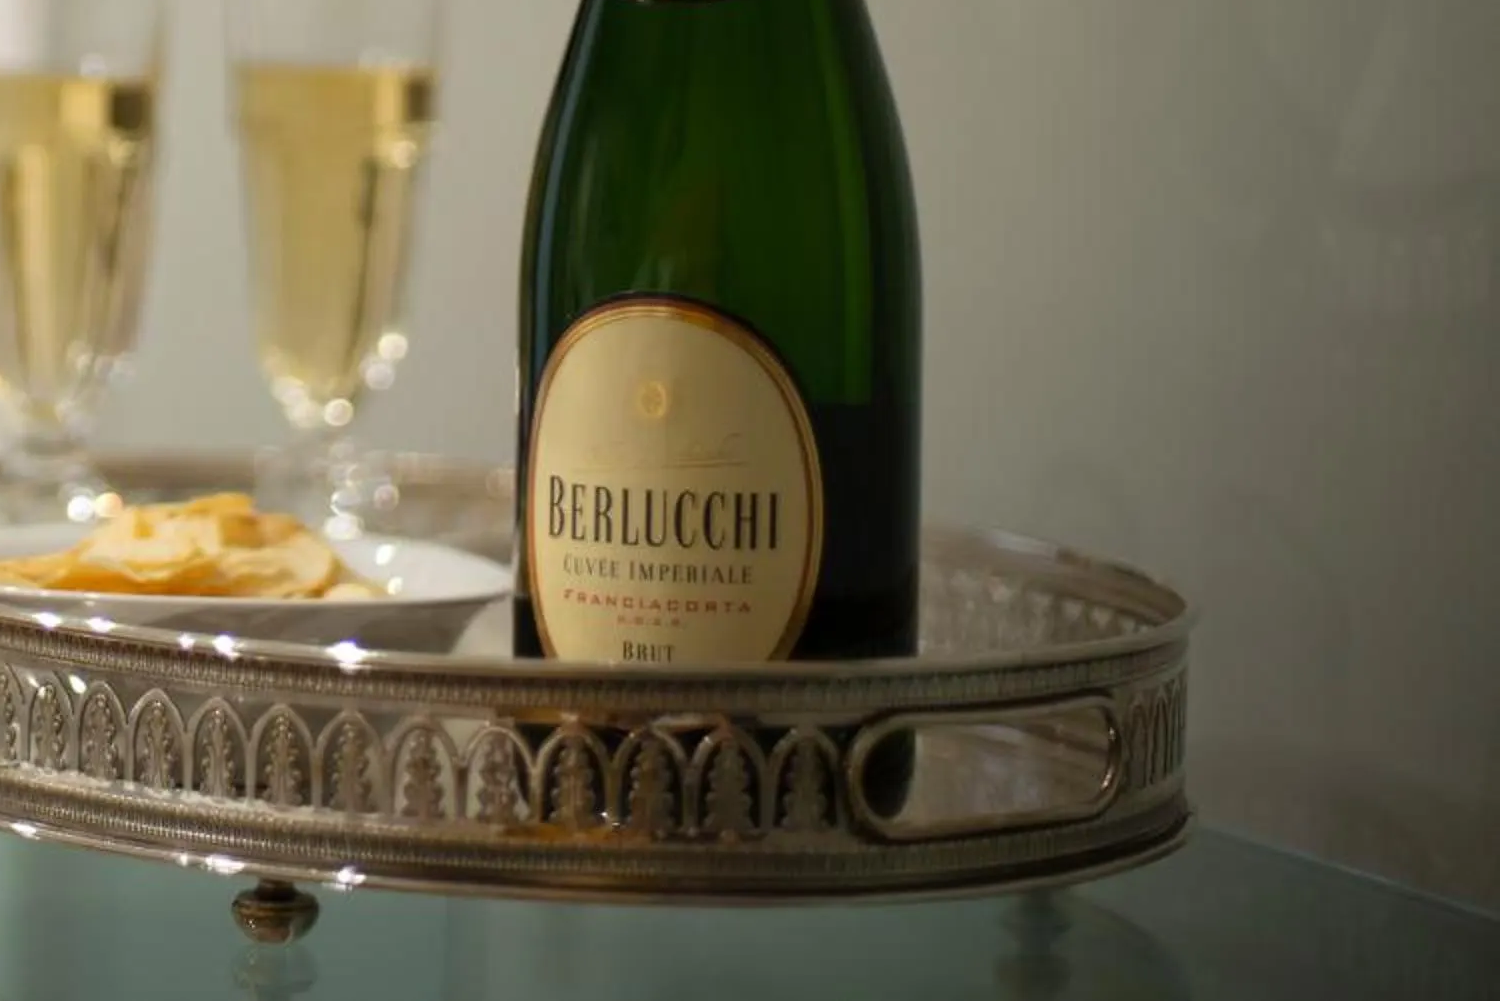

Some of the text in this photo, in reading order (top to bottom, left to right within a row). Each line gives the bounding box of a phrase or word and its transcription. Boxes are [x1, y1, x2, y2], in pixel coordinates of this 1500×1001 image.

[548, 474, 782, 551] BERLUCCHI
[628, 559, 754, 585] IMPERIALE
[563, 588, 752, 615] FRANCIACORTA
[622, 639, 676, 664] BRUT
